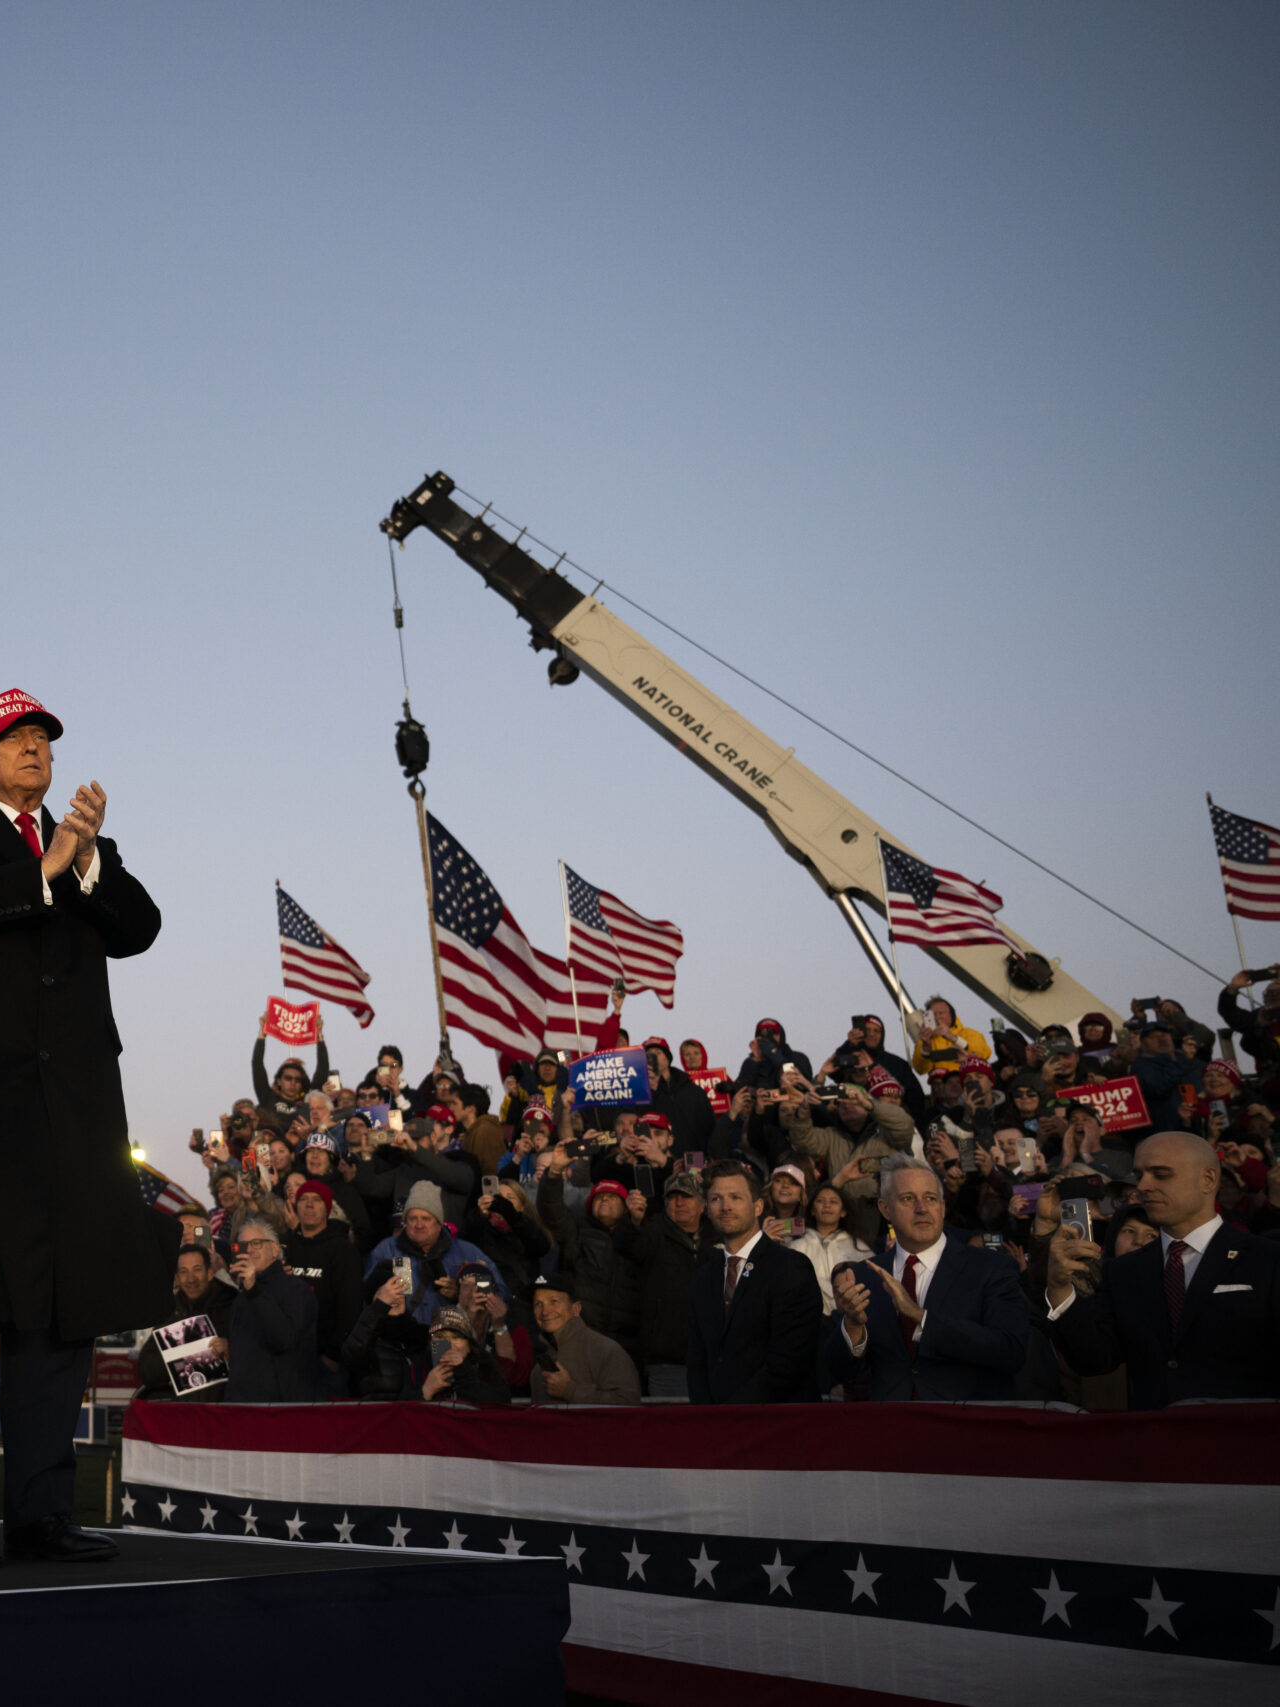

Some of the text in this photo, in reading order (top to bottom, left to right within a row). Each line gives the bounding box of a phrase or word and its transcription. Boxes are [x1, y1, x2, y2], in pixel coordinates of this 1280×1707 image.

[632, 676, 773, 790] NATIONAL CRANE
[273, 1003, 313, 1023] TRUMP
[276, 1016, 308, 1033] 2024
[585, 1056, 624, 1071] MAKE
[576, 1066, 637, 1083] AMERICA
[583, 1077, 630, 1091] GREAT
[584, 1088, 633, 1102] AGAIN!
[1073, 1086, 1133, 1106] RUMP
